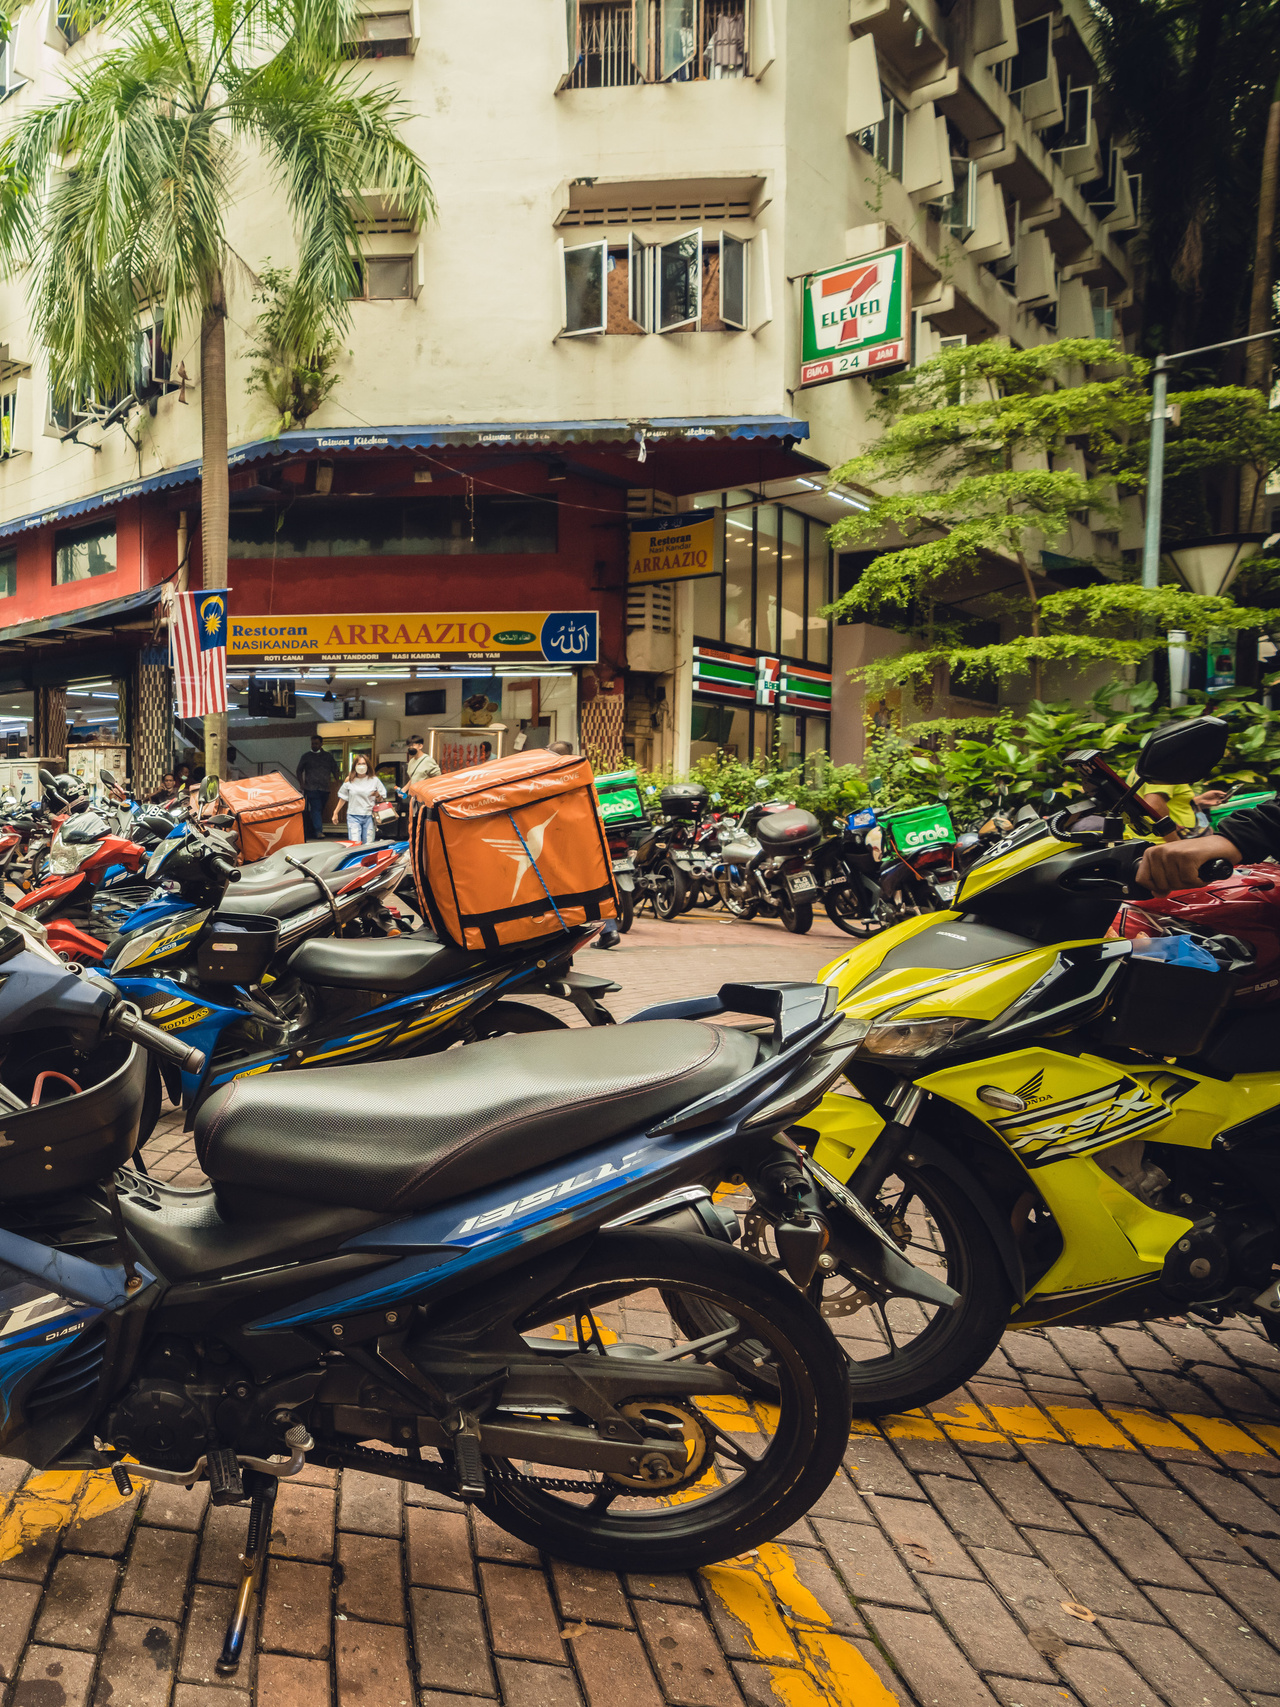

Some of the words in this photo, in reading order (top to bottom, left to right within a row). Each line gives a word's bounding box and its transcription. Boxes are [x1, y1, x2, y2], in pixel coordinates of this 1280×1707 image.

[821, 263, 878, 342] 7
[806, 365, 829, 379] BUKA
[839, 355, 860, 372] 24
[875, 347, 894, 361] JAM
[317, 437, 350, 447] Taiwan
[353, 436, 389, 446] Kitchen
[649, 534, 692, 547] Restoran
[649, 546, 664, 554] Nasi
[665, 542, 692, 552] Kandar
[632, 549, 708, 574] ARRAAZIQ
[232, 625, 308, 637] Restoran
[324, 622, 492, 649] ARRAAZIQ
[232, 639, 319, 650] NASIKANDAR
[535, 771, 580, 790] LALAMOVE
[462, 793, 507, 811] LALAMOVE
[601, 798, 635, 815] Grab
[905, 824, 949, 846] Grab
[1024, 1094, 1054, 1107] ONDA
